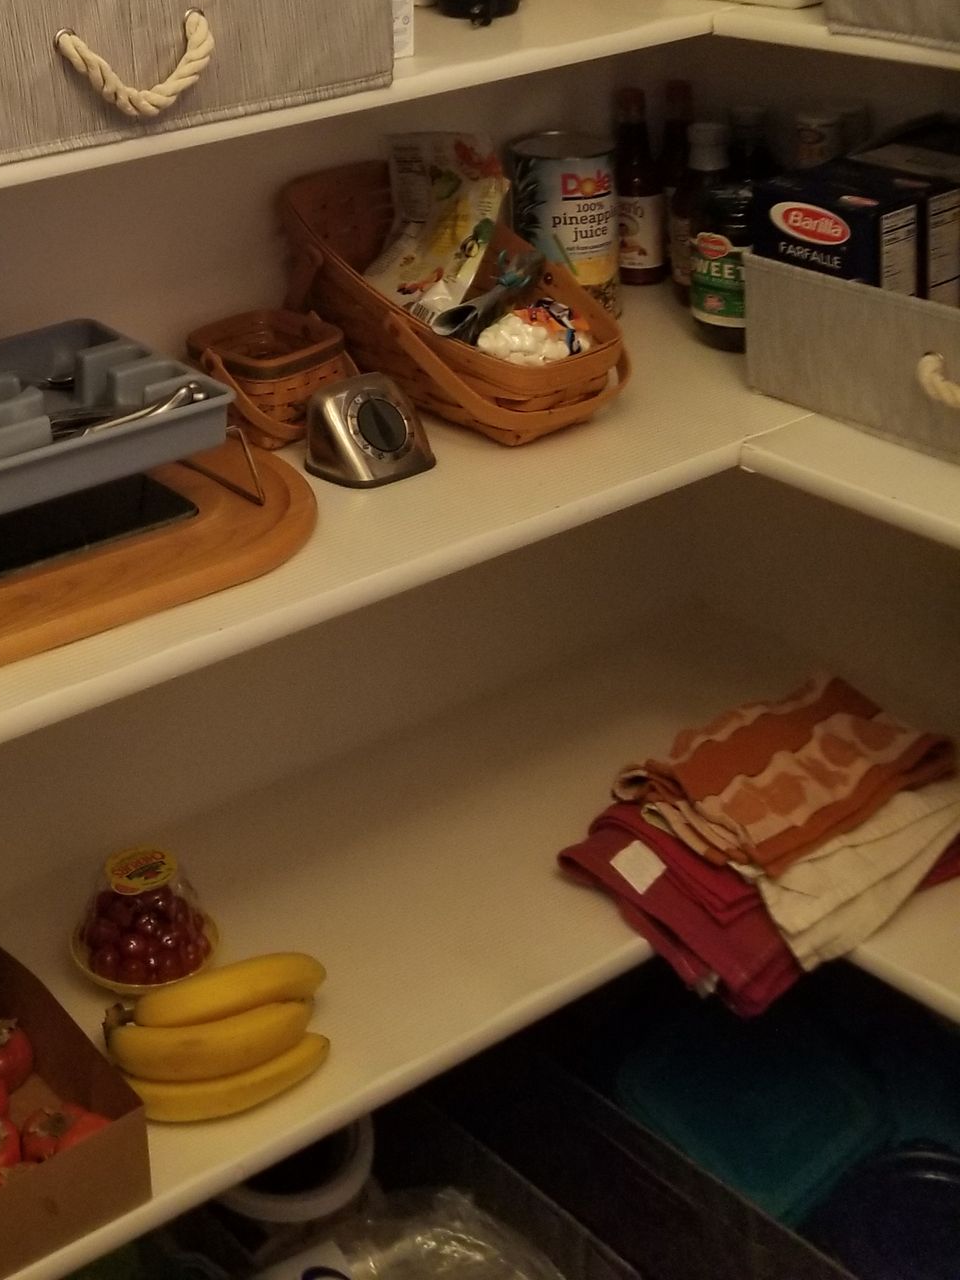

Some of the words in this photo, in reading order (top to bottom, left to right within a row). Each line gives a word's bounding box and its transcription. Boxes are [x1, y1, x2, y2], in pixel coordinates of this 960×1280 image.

[560, 169, 610, 196] Dole
[576, 201, 605, 213] 100%
[573, 225, 608, 243] juice
[788, 209, 843, 237] Barilla
[778, 241, 842, 269] FARFALLE
